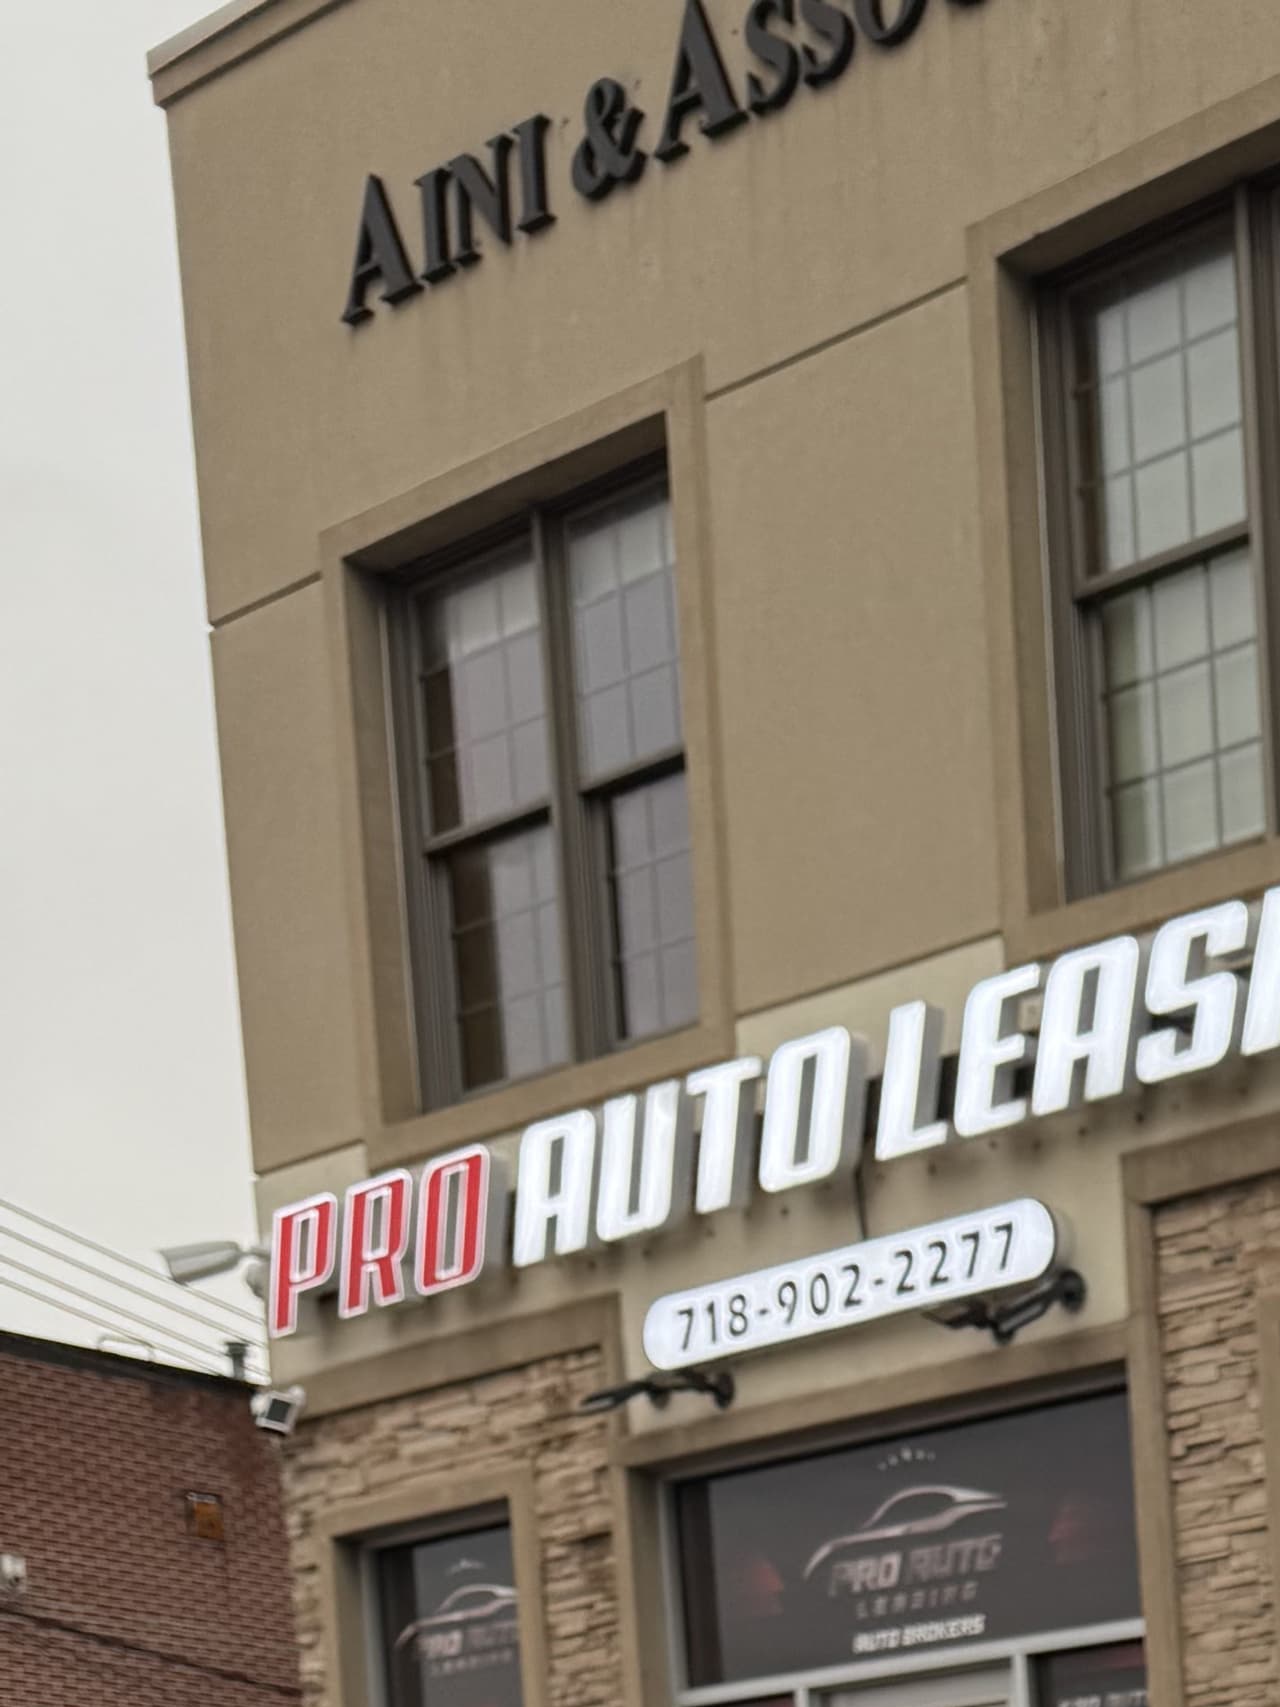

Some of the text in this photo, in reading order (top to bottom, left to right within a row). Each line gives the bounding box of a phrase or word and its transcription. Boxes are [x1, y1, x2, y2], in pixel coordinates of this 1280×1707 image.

[570, 76, 647, 204] &
[269, 1143, 492, 1339] PRO
[512, 1025, 858, 1269] AUTO
[677, 1222, 1015, 1352] 718-902-2277
[828, 1533, 1004, 1598] PRO AUTO
